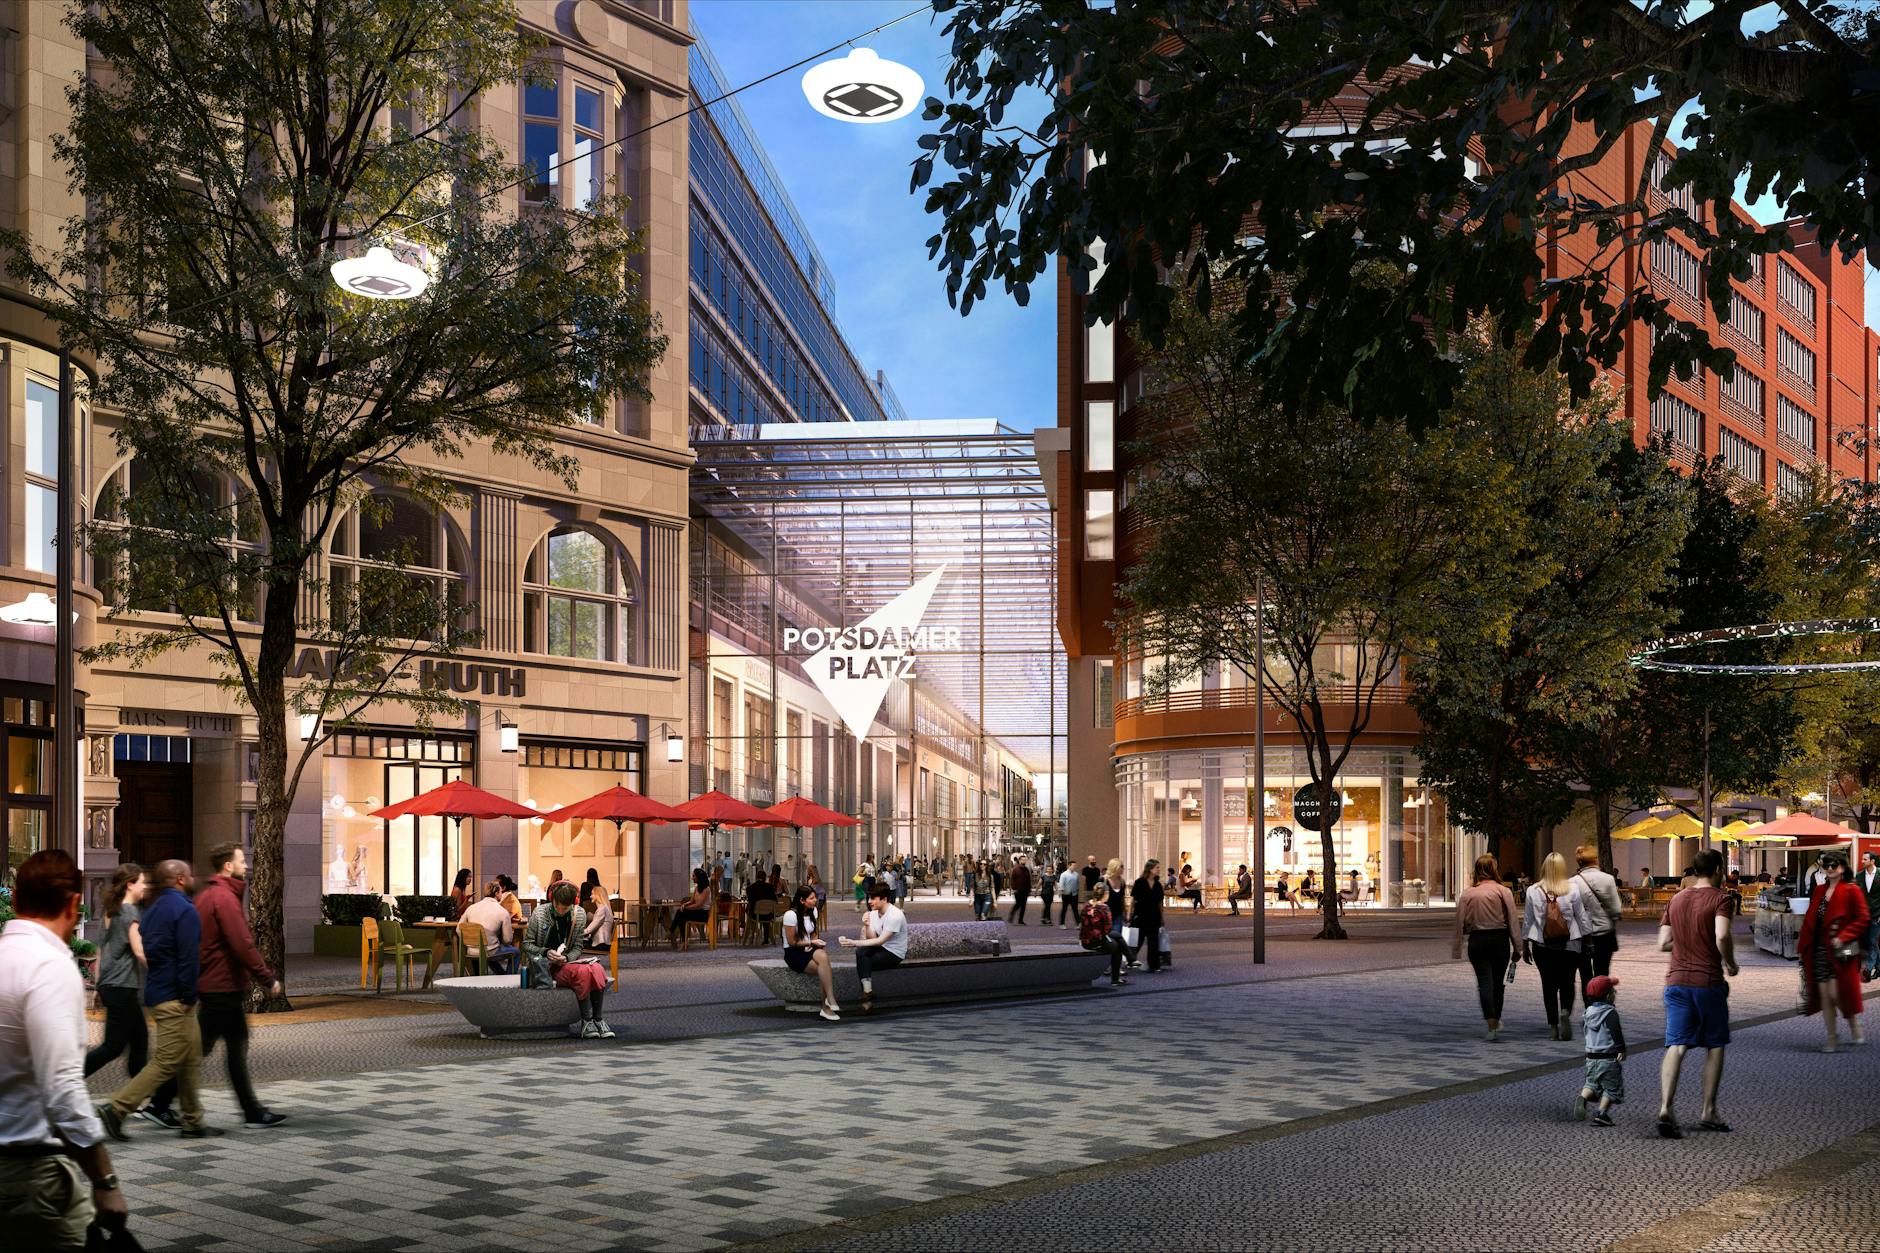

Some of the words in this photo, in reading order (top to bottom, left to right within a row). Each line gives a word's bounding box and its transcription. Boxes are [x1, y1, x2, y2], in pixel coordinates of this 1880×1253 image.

[783, 626, 962, 651] POTSDAMER
[420, 659, 526, 698] HUTH
[829, 656, 917, 680] PLATZ
[119, 709, 167, 727] HAUS
[186, 713, 234, 732] HUTH
